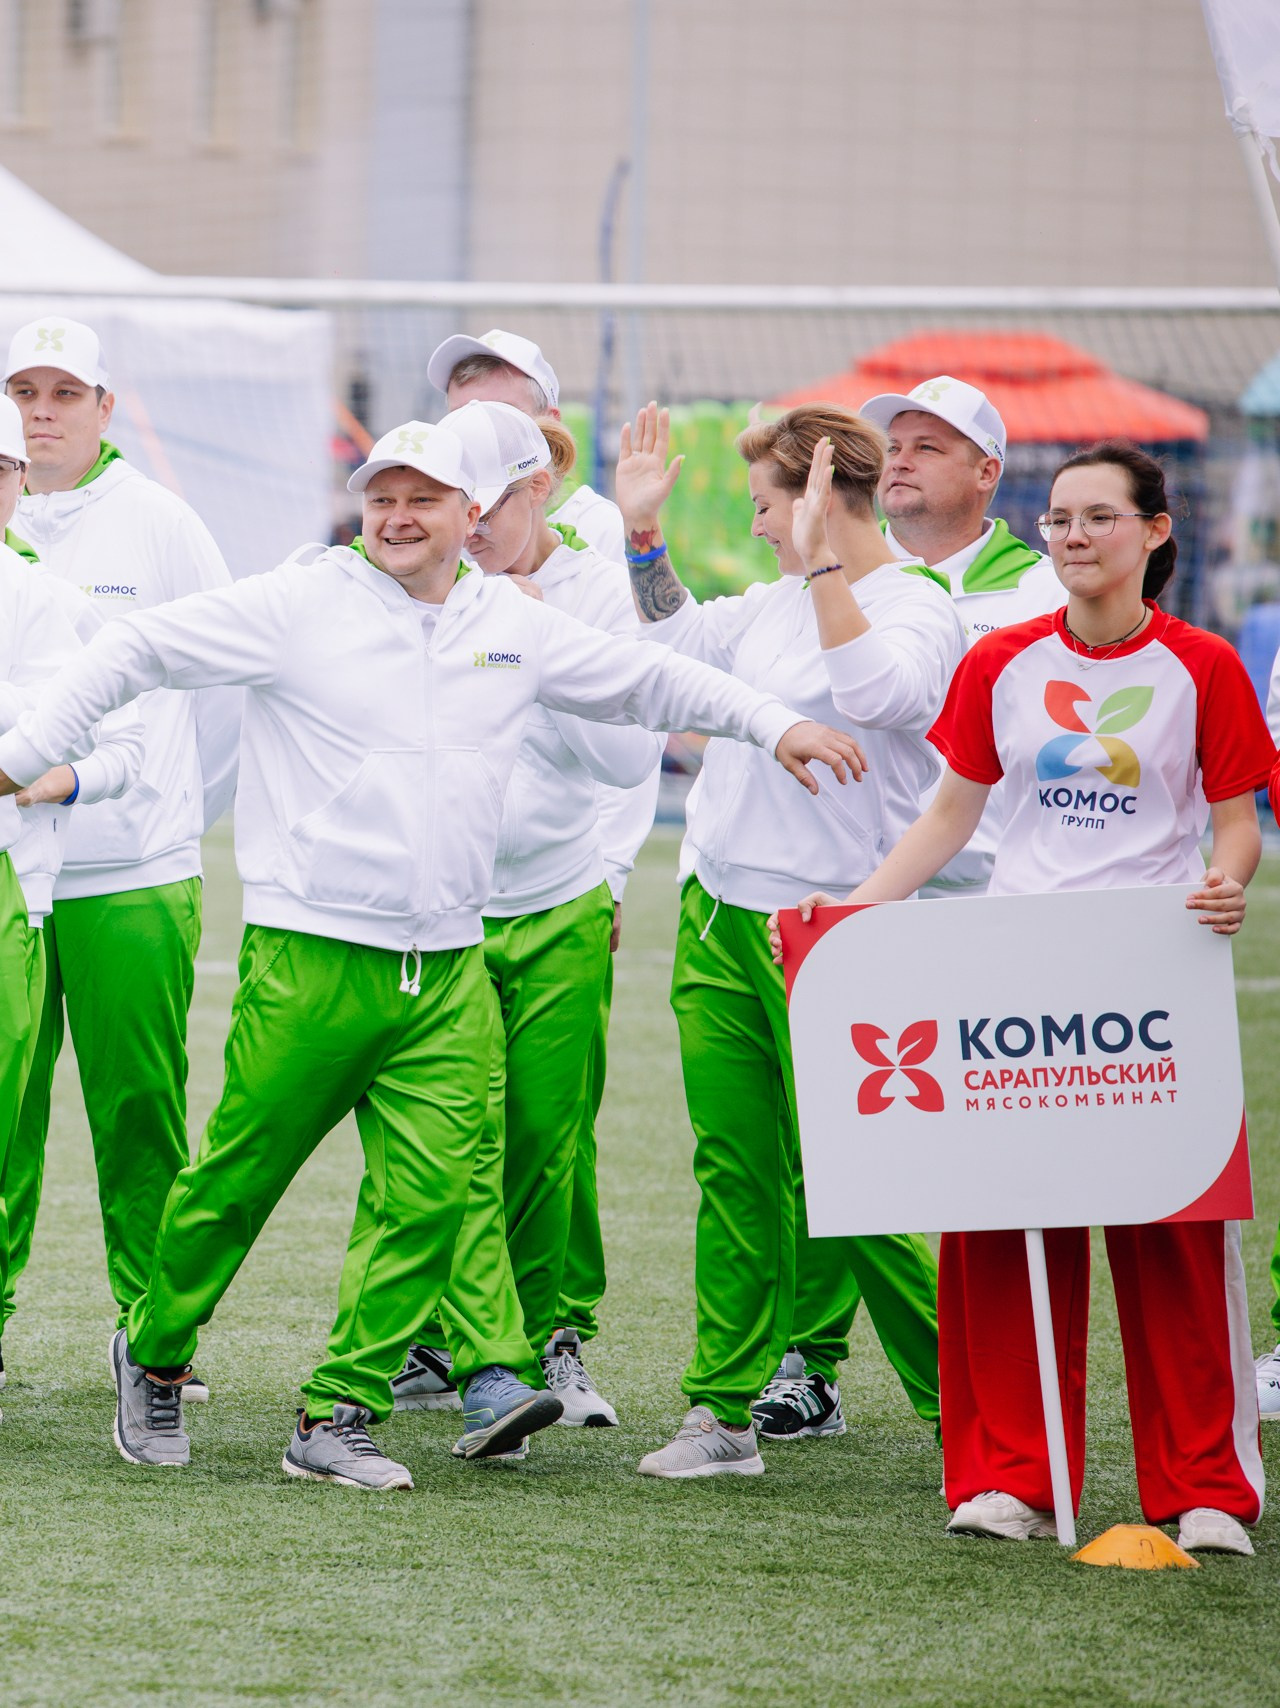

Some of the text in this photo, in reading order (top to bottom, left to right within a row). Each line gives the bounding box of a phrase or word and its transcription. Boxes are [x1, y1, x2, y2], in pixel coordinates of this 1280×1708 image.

[94, 585, 137, 595] КОМОС
[488, 652, 522, 664] КОМОС
[1039, 788, 1137, 815] КОМОС
[1061, 815, 1105, 830] ГРУПП
[959, 1010, 1173, 1061] КОМОС
[964, 1057, 1177, 1091] САРАПУЛЬСКИЙ
[966, 1090, 1177, 1111] МЯСОКОМБИНАТ
